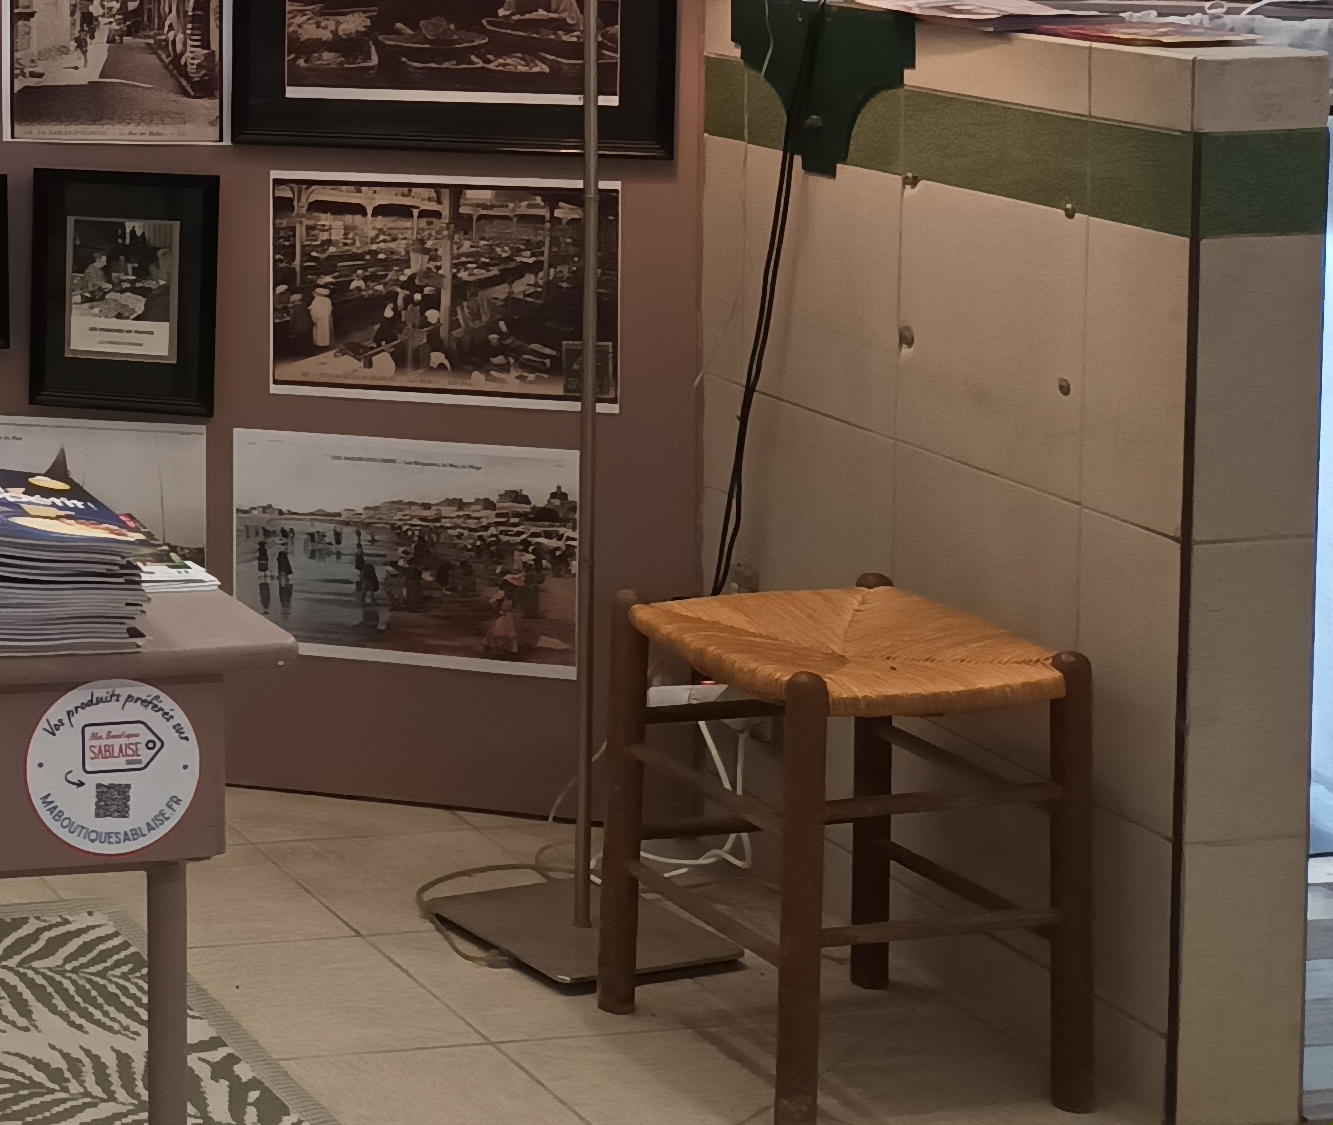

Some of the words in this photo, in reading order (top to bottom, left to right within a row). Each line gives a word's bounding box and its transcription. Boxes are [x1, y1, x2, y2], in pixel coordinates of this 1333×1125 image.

[41, 717, 66, 737] Vos
[66, 688, 122, 728] produits
[121, 692, 175, 723] préférés
[88, 741, 143, 761] SABLAISE
[39, 792, 183, 845] MABOUTIQUESABLAISE.FR
